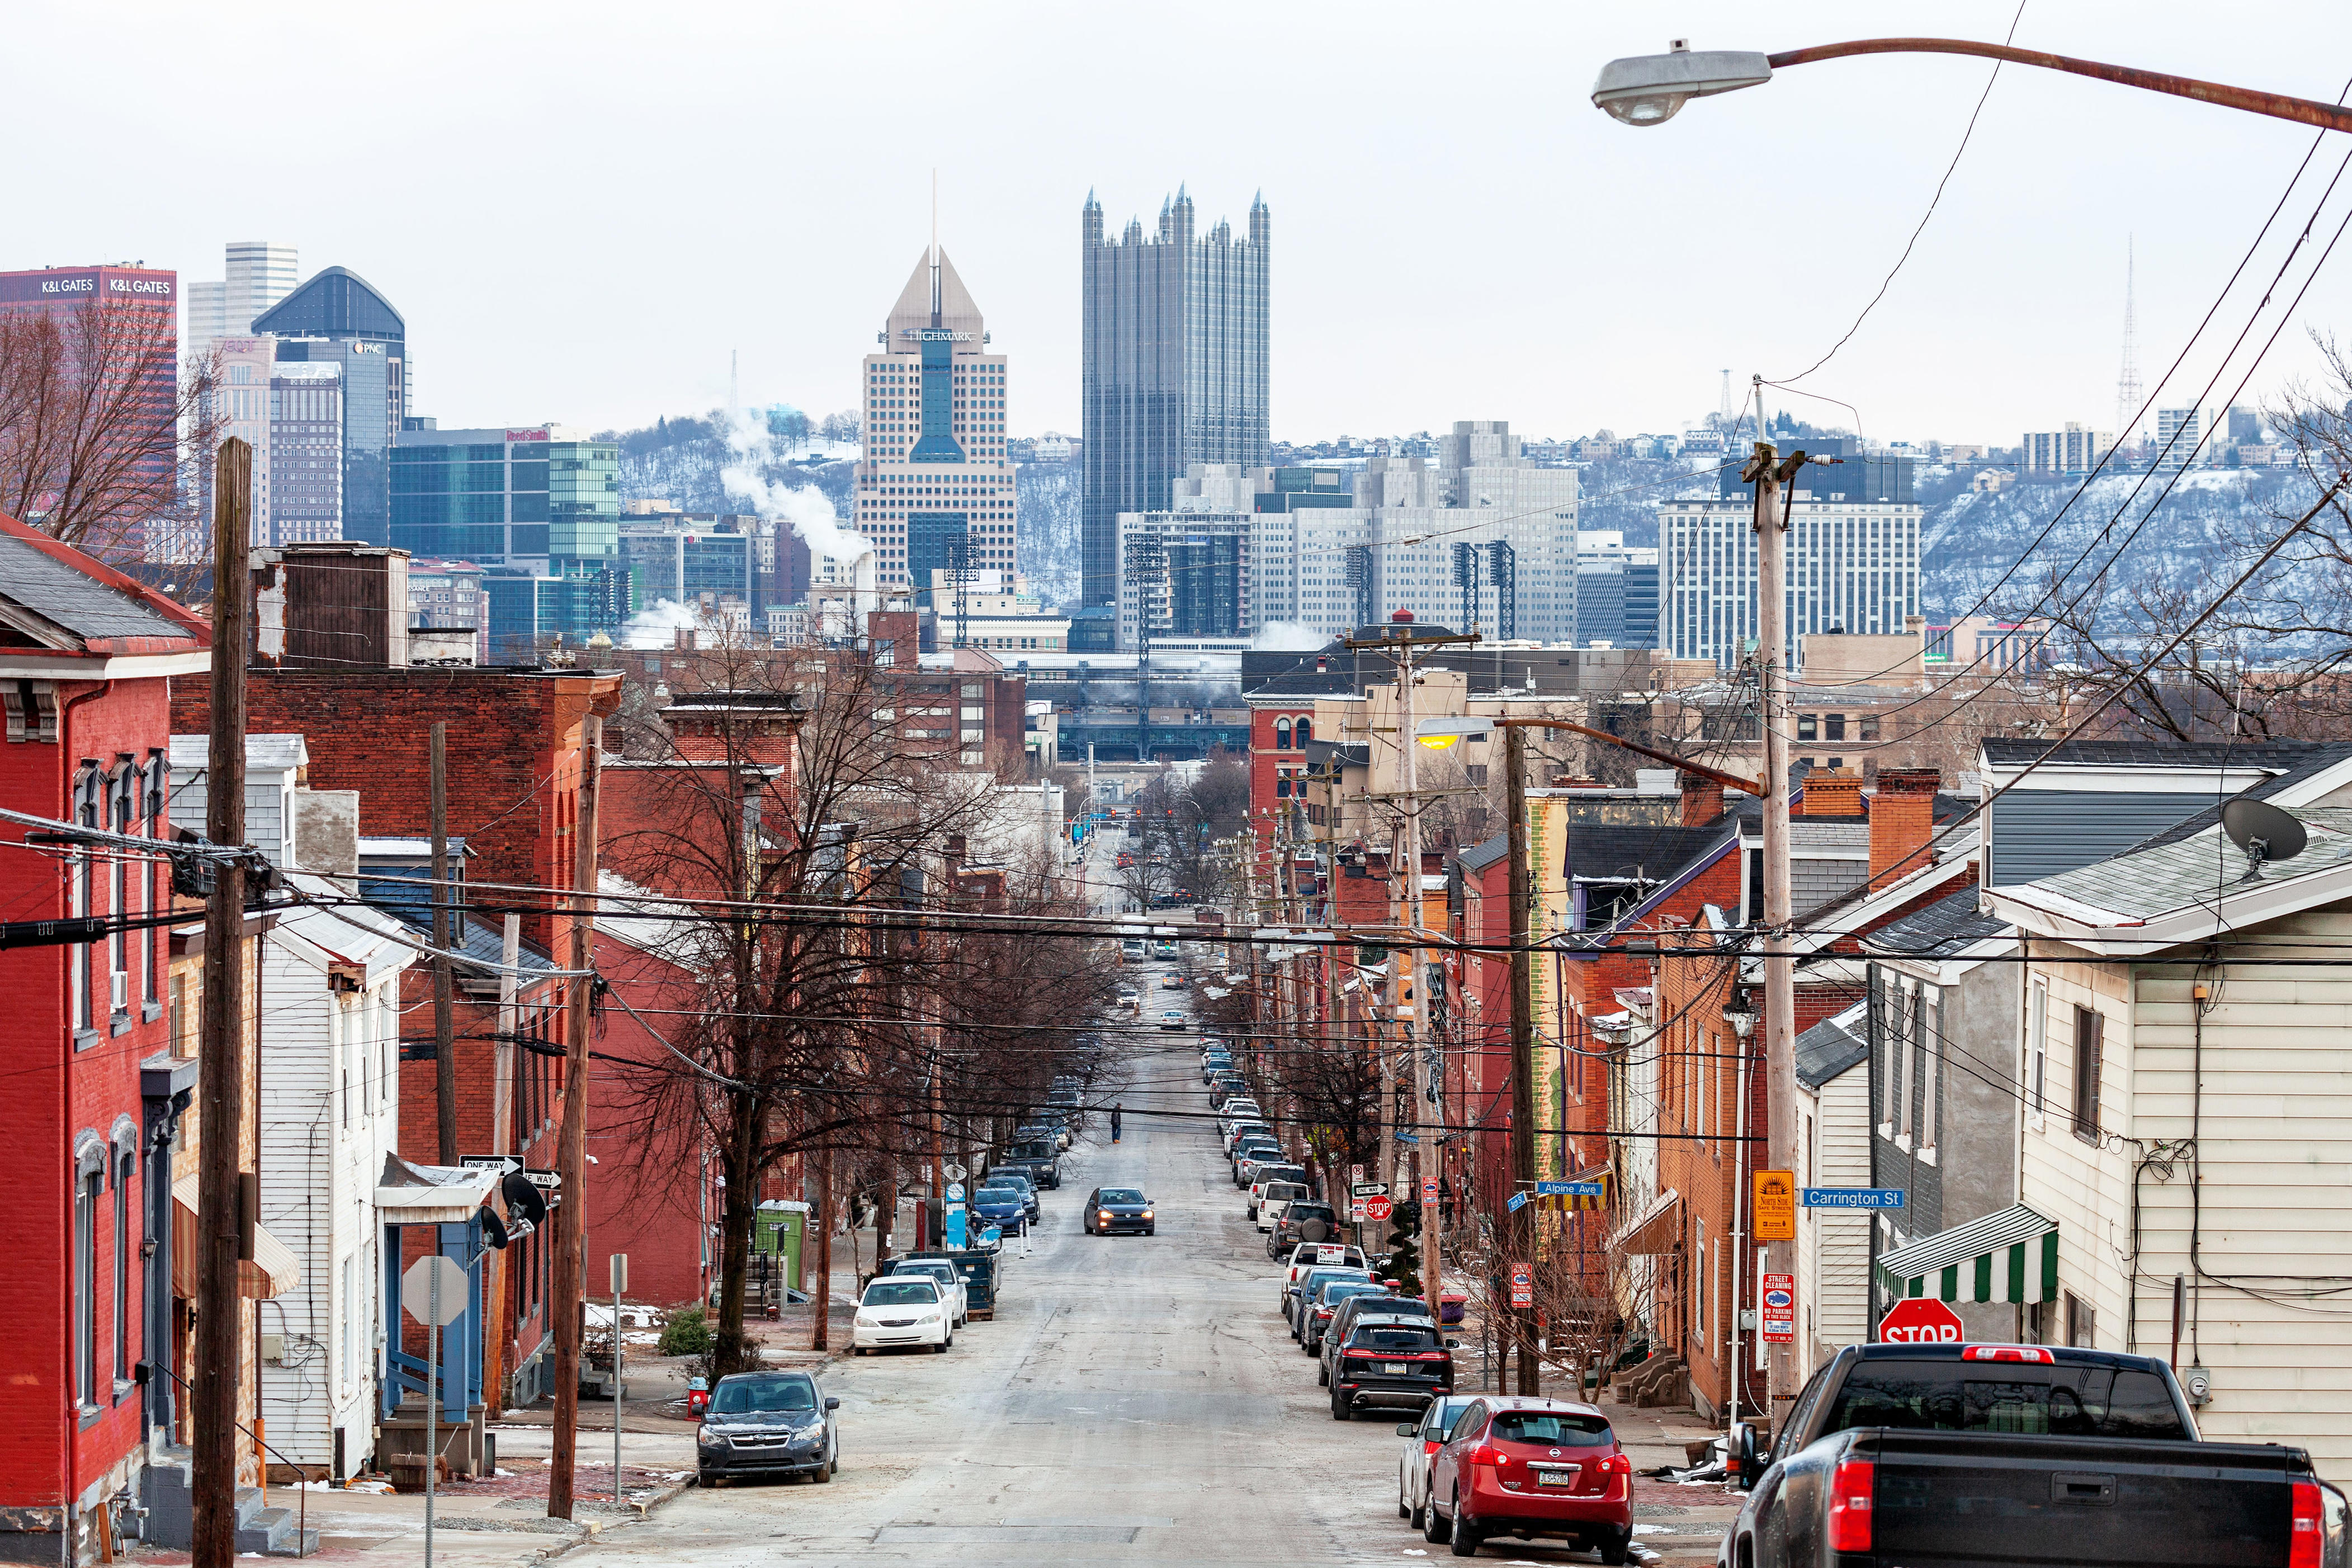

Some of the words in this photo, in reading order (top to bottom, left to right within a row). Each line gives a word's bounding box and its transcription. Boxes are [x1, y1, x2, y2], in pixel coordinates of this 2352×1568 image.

[42, 281, 60, 292] K&L
[61, 279, 93, 291] GATES
[110, 279, 131, 292] K&L
[133, 280, 170, 294] GATES
[910, 330, 972, 342] HIGHMARK
[225, 339, 255, 352] EQT
[363, 344, 381, 353] PNC
[507, 429, 525, 441] Reed
[526, 429, 547, 440] Smith
[1545, 1184, 1574, 1193] Alpine
[1579, 1185, 1596, 1193] Ave
[1760, 1197, 1776, 1205] NORTH
[1777, 1196, 1788, 1206] SIDE
[1810, 1191, 1879, 1207] Carrington
[1885, 1192, 1898, 1205] St
[1368, 1202, 1390, 1213] STOP
[1886, 1325, 1957, 1343] STOP
